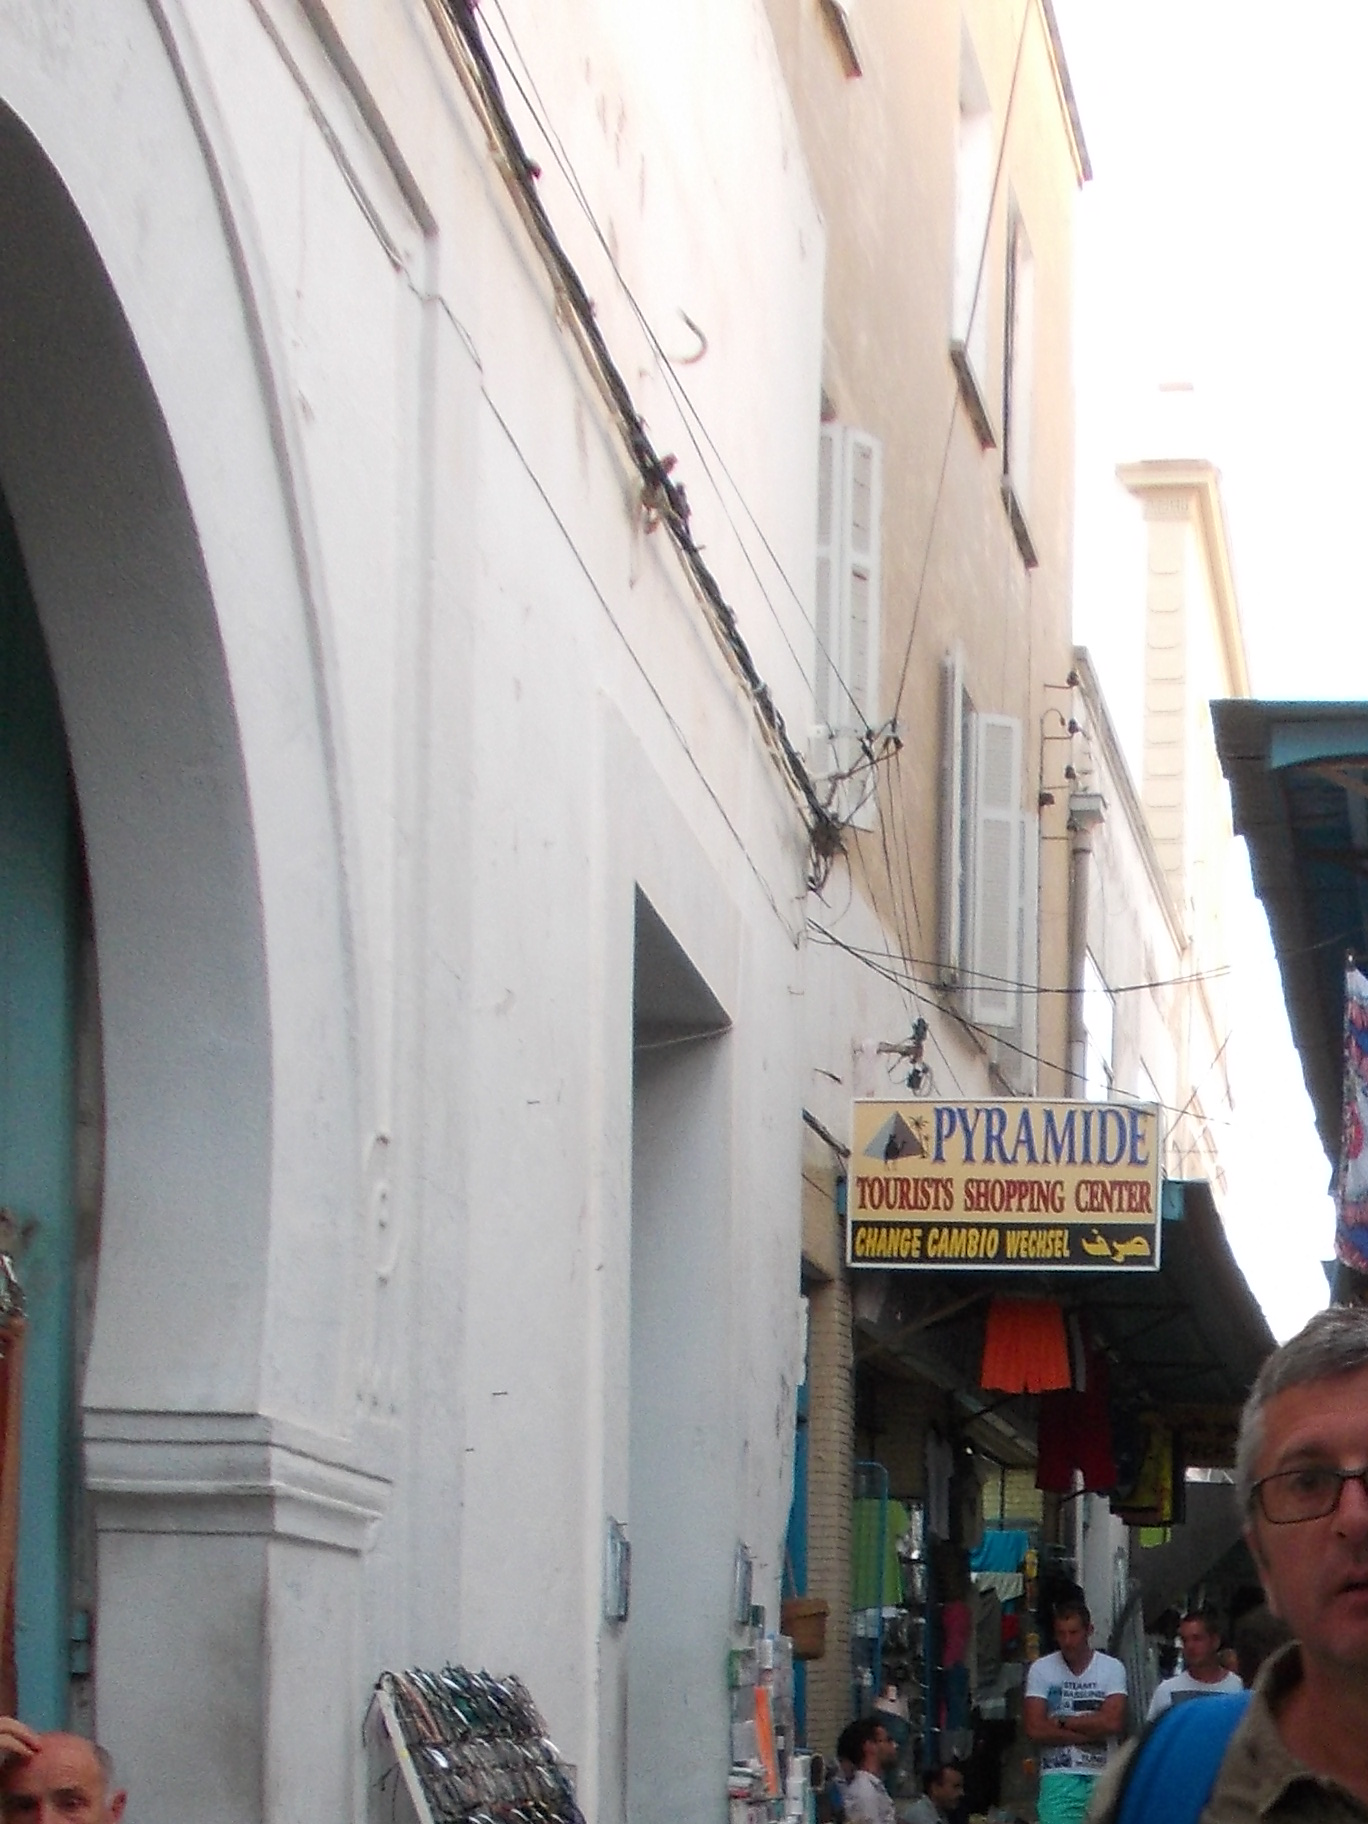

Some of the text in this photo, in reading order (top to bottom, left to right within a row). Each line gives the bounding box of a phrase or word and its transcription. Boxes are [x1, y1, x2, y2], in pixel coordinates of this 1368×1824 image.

[931, 1106, 1150, 1166] PYRAMIDE
[856, 1176, 1152, 1214] TOURISTS SHOPPING CENTER
[855, 1227, 1070, 1258] CHANGE CAMBIO WECHSEL
[1081, 1228, 1151, 1262] صرف
